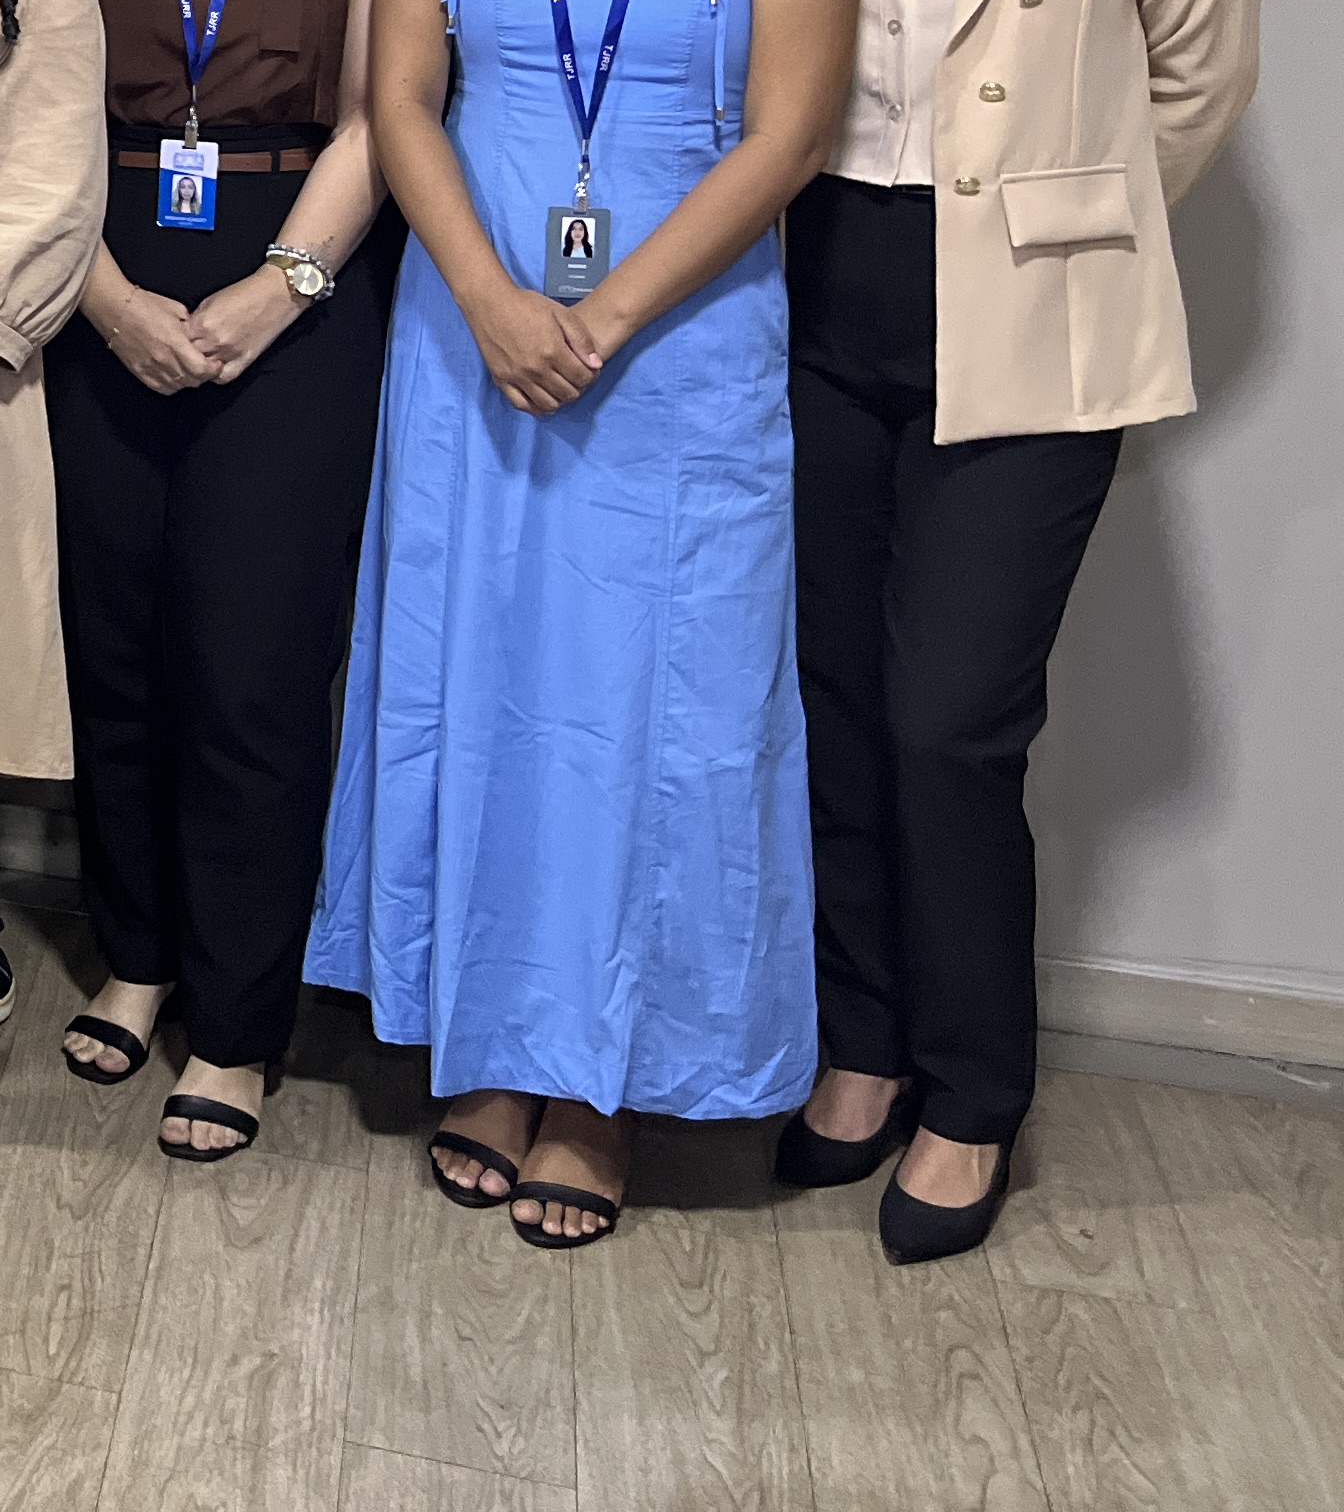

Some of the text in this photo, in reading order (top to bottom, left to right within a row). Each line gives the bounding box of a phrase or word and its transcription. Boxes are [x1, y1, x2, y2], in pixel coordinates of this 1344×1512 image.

[206, 11, 220, 36] TJRR
[563, 53, 575, 80] TJRR
[600, 45, 614, 71] TJRR
